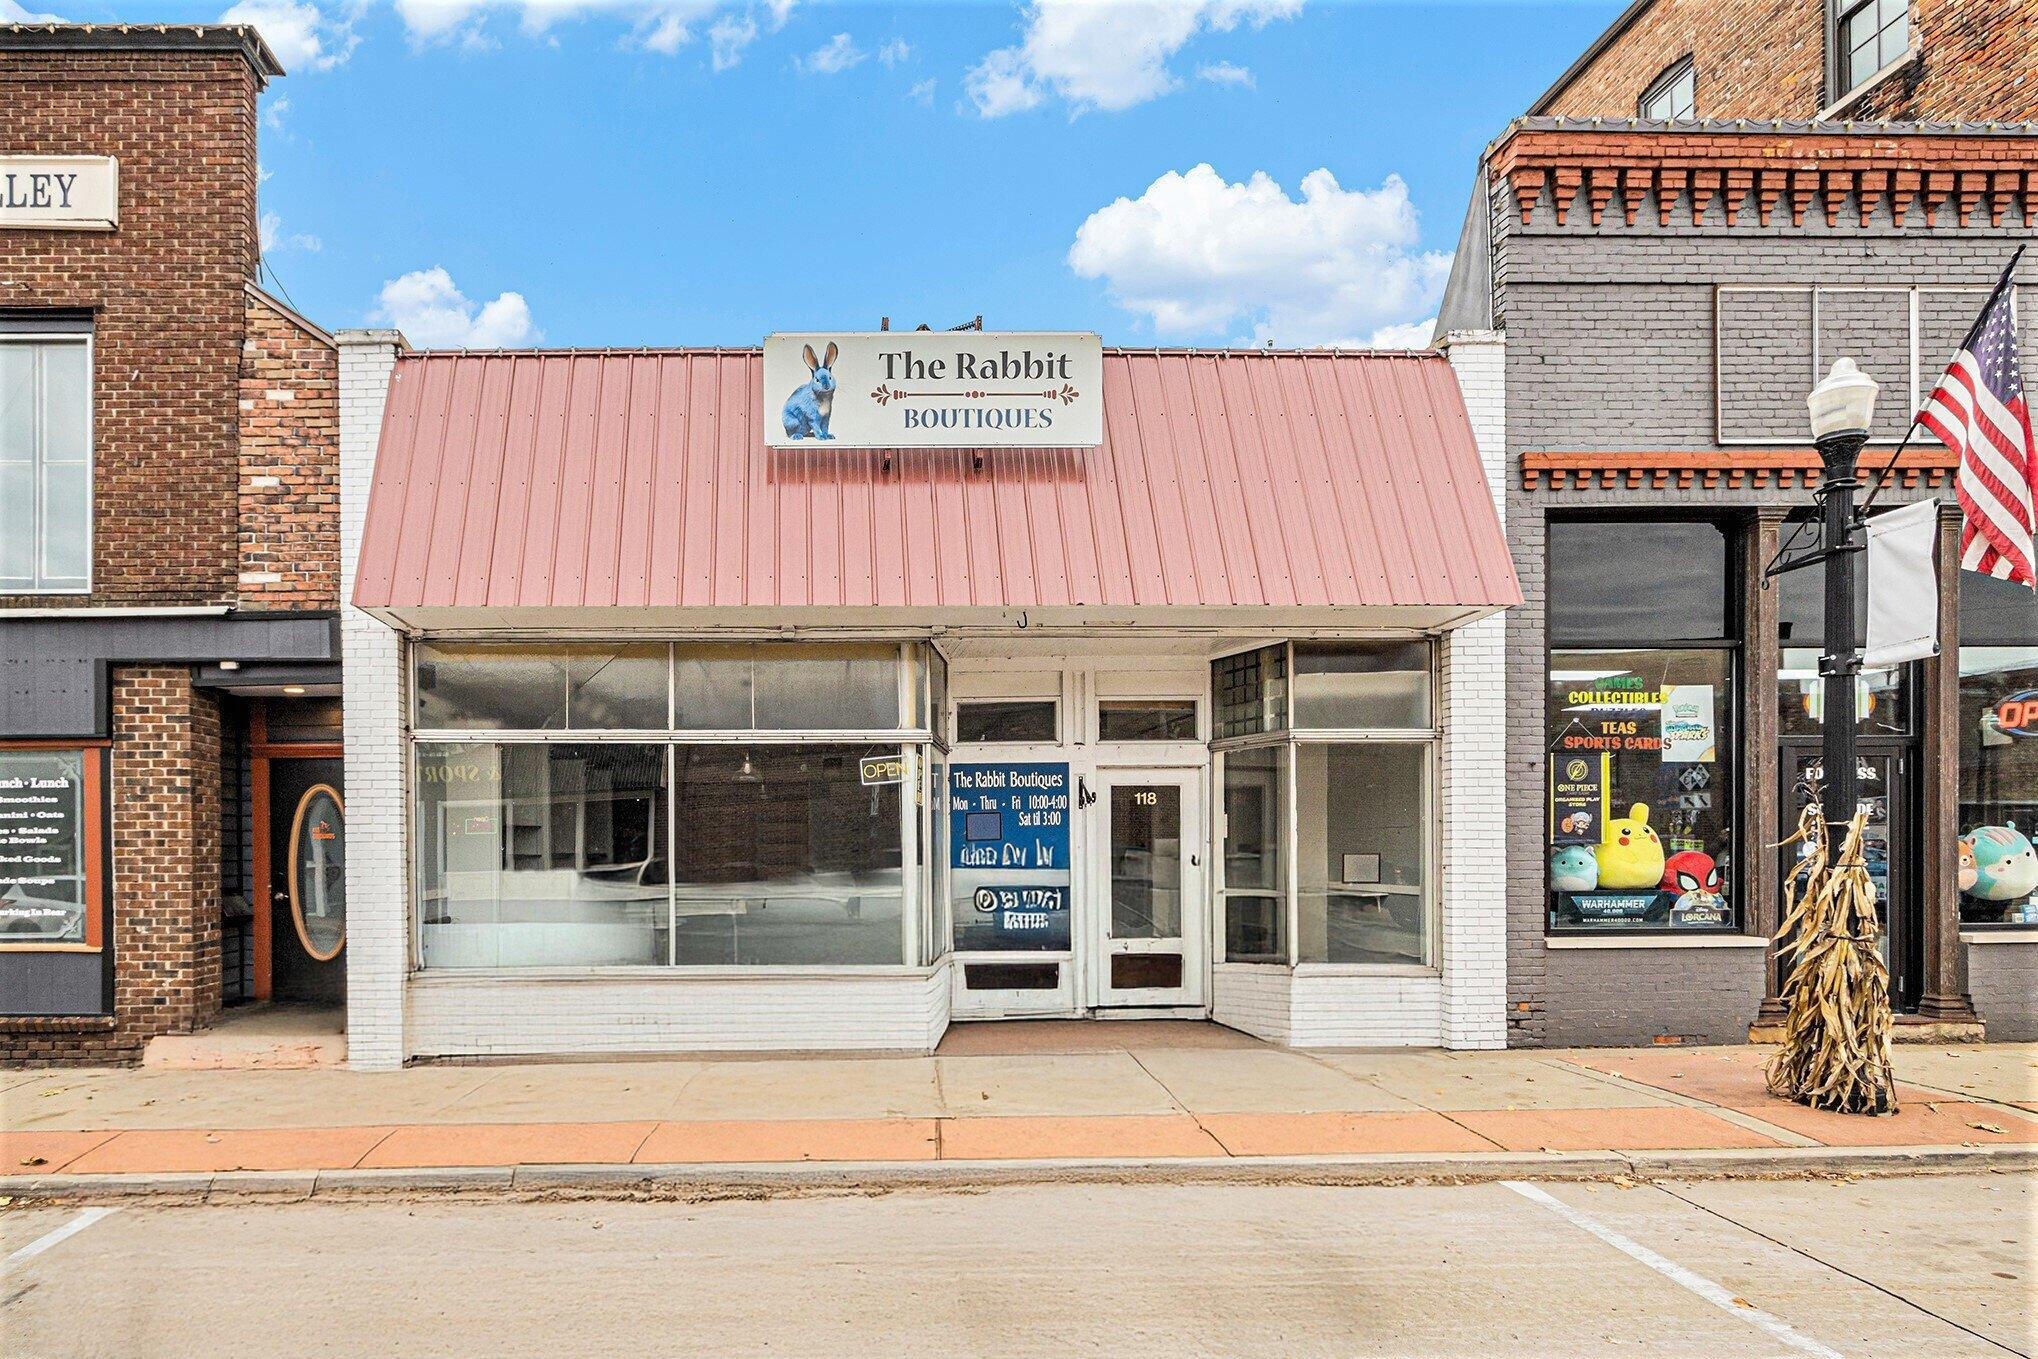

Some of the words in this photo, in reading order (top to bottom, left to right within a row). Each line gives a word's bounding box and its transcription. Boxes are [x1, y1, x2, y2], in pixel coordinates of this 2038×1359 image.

[0, 174, 77, 208] LEY
[878, 351, 946, 380] The
[955, 351, 1073, 380] Rabbit
[904, 408, 1053, 430] BOUTIQUES
[1568, 691, 1669, 705] COLLECTIBLES
[1601, 721, 1637, 734] TEAS
[1564, 736, 1621, 749] SPORTS
[1625, 737, 1672, 750] CARDS
[864, 762, 909, 779] OPEN
[30, 777, 69, 788] Lunch
[954, 771, 973, 788] The
[975, 771, 1006, 788] Rabbit
[1010, 771, 1063, 790] Boutiques
[1557, 784, 1575, 792] ONE
[1576, 784, 1598, 792] PIECE
[952, 796, 969, 810] Mon
[980, 795, 997, 810] Thru
[1011, 795, 1021, 810] Fri
[1029, 795, 1067, 810] 10:00-4:00
[1134, 792, 1157, 805] 118
[1018, 811, 1031, 826] Sat
[1033, 811, 1041, 826] til
[1043, 811, 1061, 826] 3:00
[18, 827, 59, 835] Salads
[9, 836, 48, 844] Bowls
[22, 855, 62, 863] Goods
[18, 876, 56, 886] Soups
[1582, 900, 1645, 909] WARHAMMER
[30, 908, 42, 916] In
[1681, 912, 1722, 922] LORCANA
